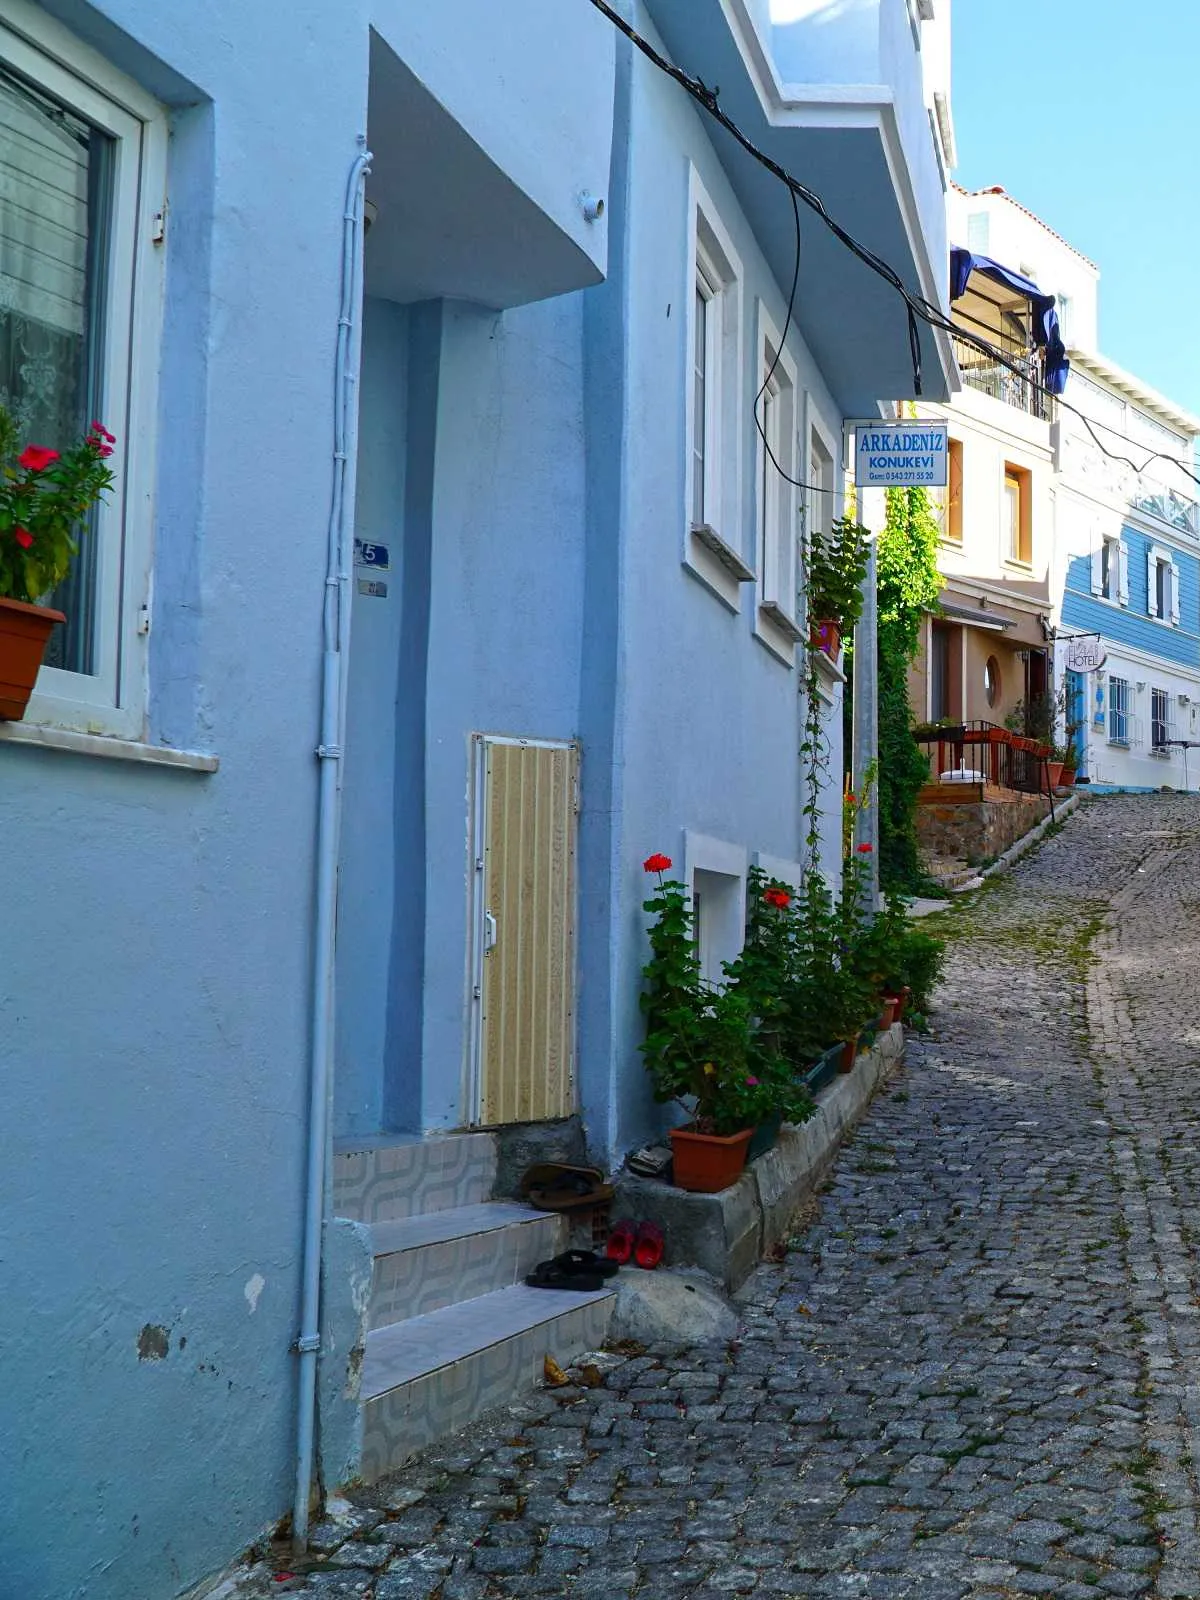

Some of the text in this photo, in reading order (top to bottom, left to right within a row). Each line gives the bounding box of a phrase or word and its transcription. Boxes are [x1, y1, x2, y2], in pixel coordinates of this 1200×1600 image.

[860, 431, 943, 452] ARKADENİZ
[869, 454, 934, 468] KONUKEVİ
[1069, 655, 1098, 667] HOTEL
